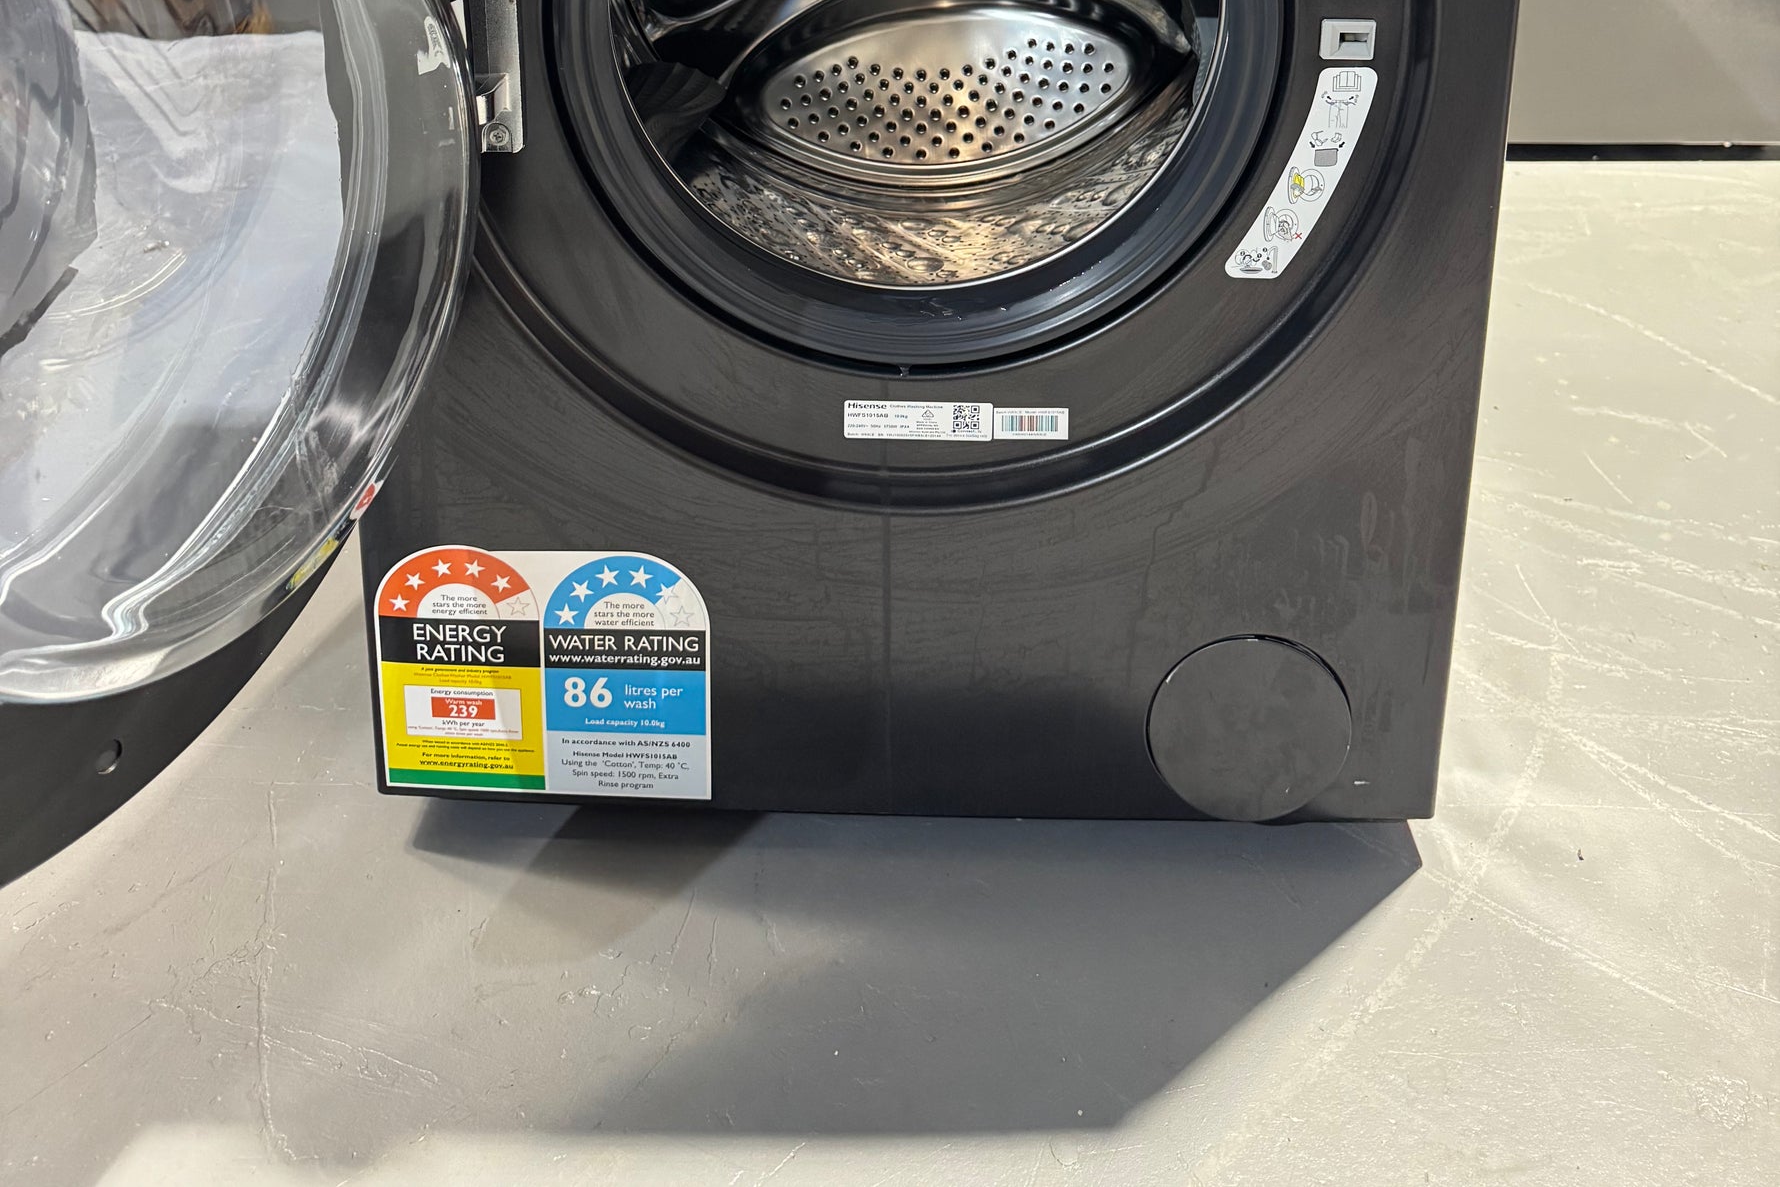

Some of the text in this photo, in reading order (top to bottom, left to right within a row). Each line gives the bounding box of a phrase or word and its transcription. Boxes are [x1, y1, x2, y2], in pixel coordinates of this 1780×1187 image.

[604, 601, 620, 609] The
[621, 619, 654, 627] efficient
[413, 623, 507, 643] ENERGY
[549, 635, 699, 652] WATER RATING
[416, 643, 505, 663] RATING
[549, 654, 701, 666] www.waterrating.gov.au
[564, 676, 613, 709] 86
[624, 684, 683, 699] litres per
[624, 698, 656, 709] wash
[449, 705, 478, 717] 239
[606, 718, 638, 727] capacity
[640, 719, 665, 728] 10.0kg
[420, 760, 514, 770] www.energyrating.gov.au
[561, 759, 583, 767] Using
[638, 761, 663, 770] Temp:
[572, 769, 588, 777] Spin
[590, 770, 615, 778] speed:
[638, 772, 656, 780] rpm,
[659, 772, 679, 780] Extra
[598, 780, 654, 790] Rinse program
